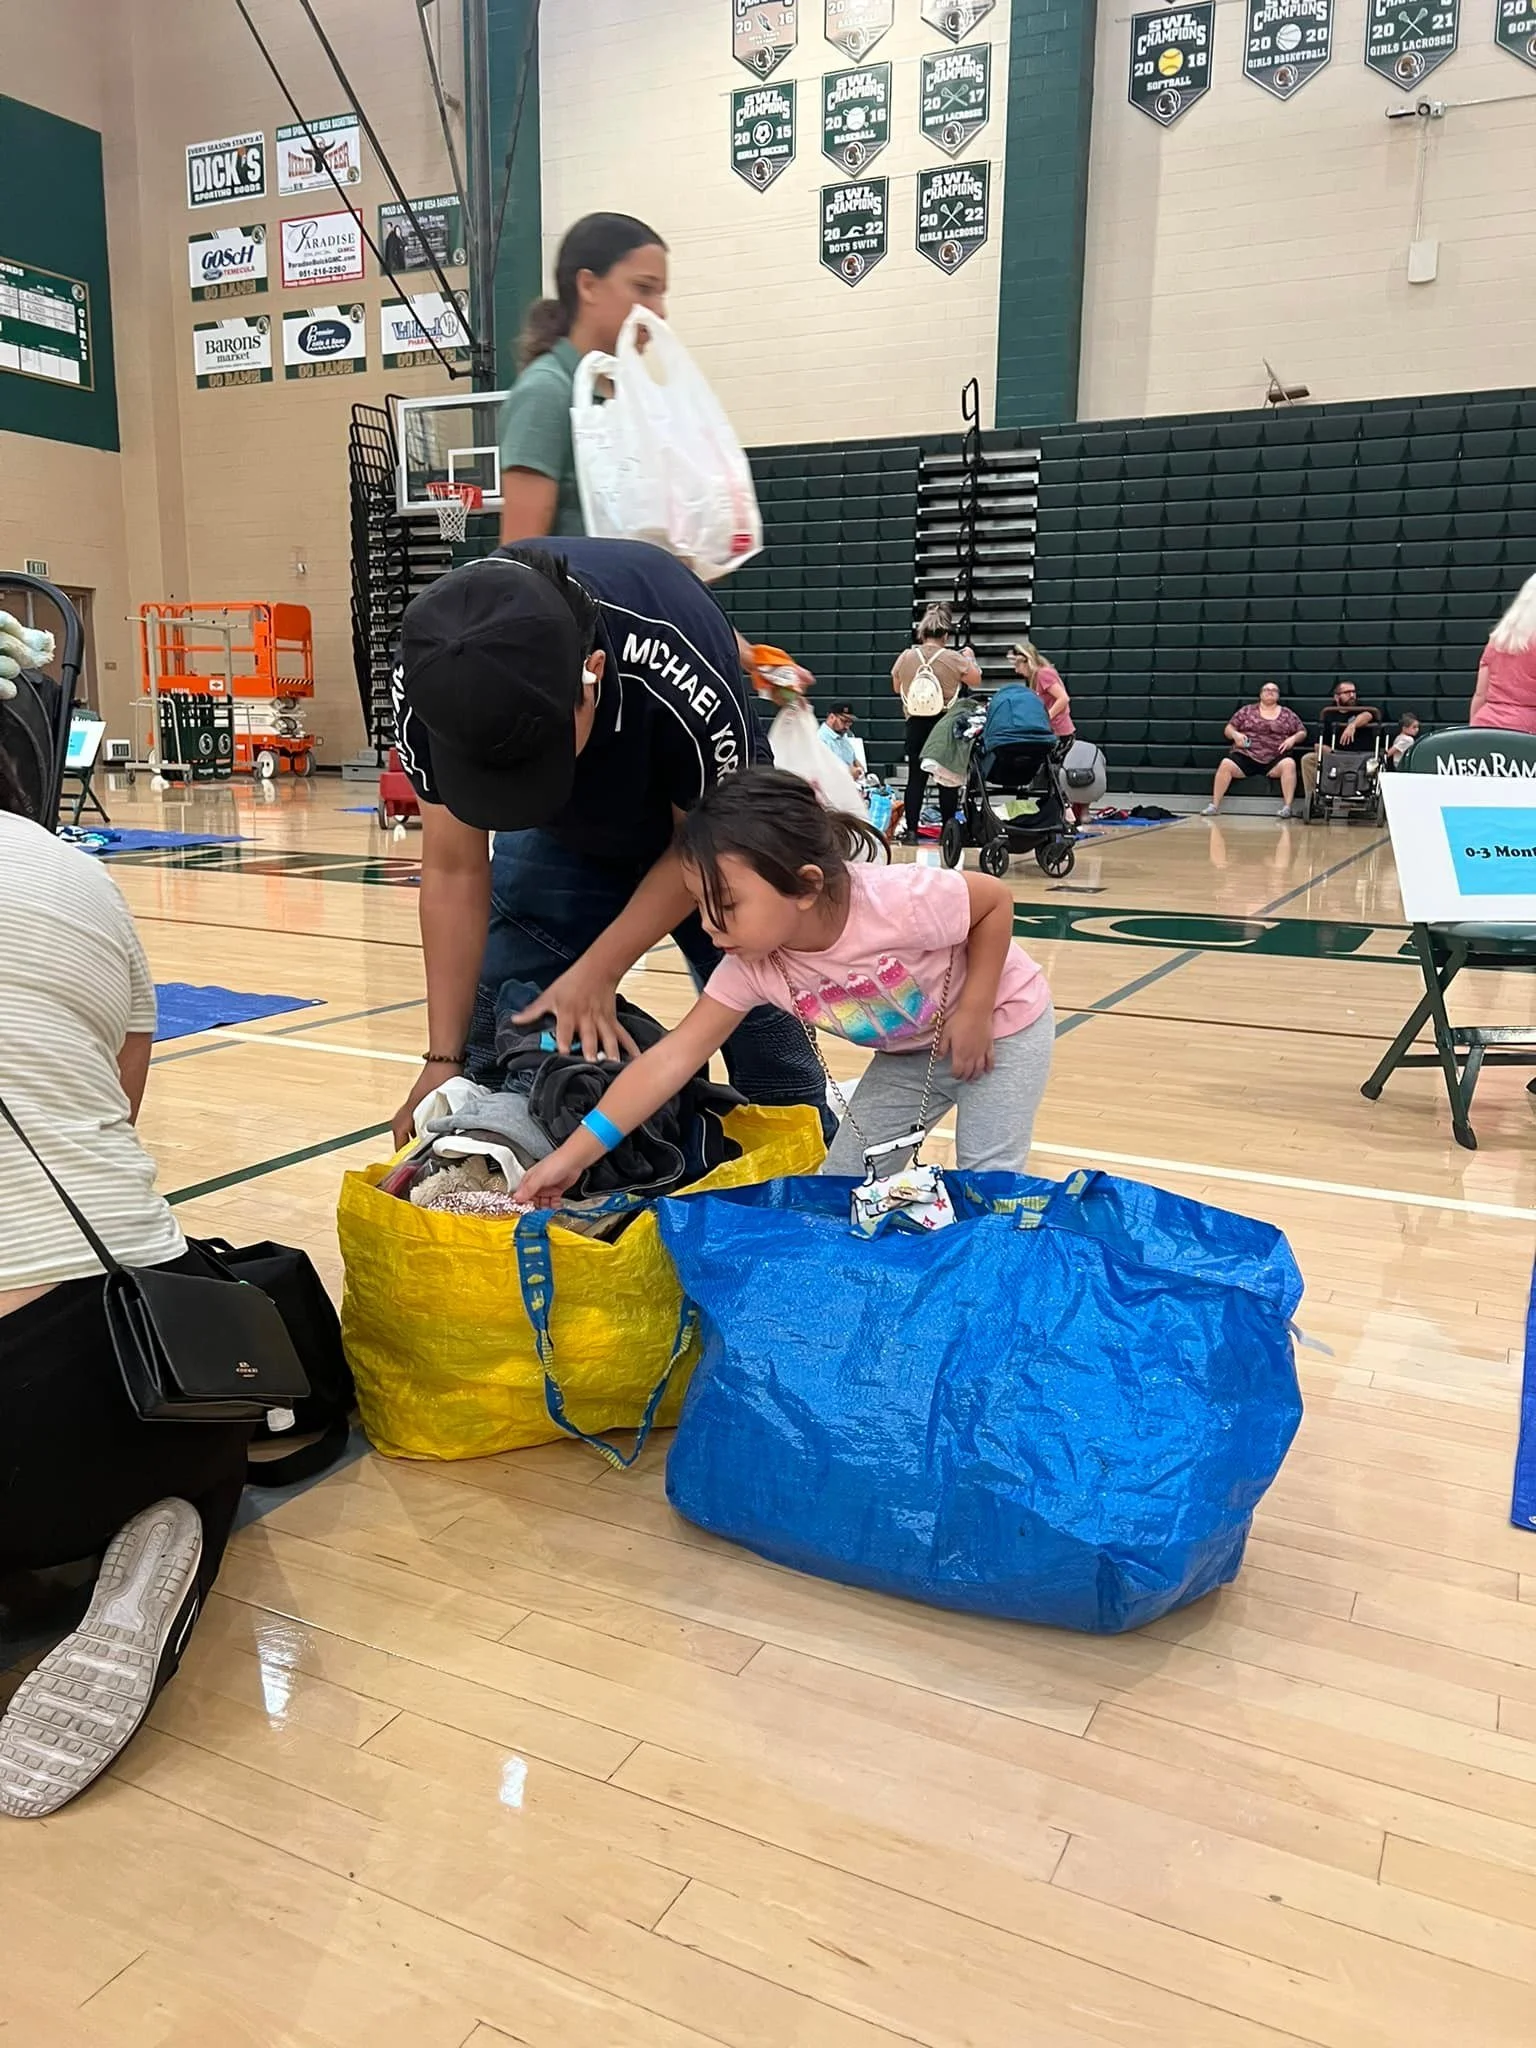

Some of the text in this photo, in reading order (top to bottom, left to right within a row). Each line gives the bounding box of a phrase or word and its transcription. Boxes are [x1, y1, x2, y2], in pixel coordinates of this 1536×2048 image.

[1254, 2, 1328, 32] CHAMPIONS
[1503, 0, 1527, 17] 20
[735, 20, 752, 34] 20
[1149, 13, 1197, 33] SWL
[1372, 13, 1454, 39] 20 21
[1137, 25, 1207, 56] CHAMPIONS
[1250, 27, 1328, 52] 20 20
[1402, 34, 1454, 50] LACROSSE
[1134, 53, 1207, 77] 20 18
[926, 64, 985, 92] CHAMPIONS
[1146, 76, 1191, 91] SOFTBALL
[827, 83, 886, 111] CHAMPIONS
[924, 89, 985, 112] 20 17
[736, 97, 791, 127] CHAMPIONS
[825, 109, 886, 132] 20 16
[734, 125, 792, 146] 20 15
[834, 130, 876, 145] BASEBALL
[192, 147, 262, 193] DICK'S
[932, 171, 975, 188] SWL
[834, 187, 874, 202] SWL
[923, 181, 983, 208] CHAMPIONS
[826, 196, 882, 222] CHAMPIONS
[920, 207, 984, 227] 20 22
[824, 221, 883, 241] 20 22
[944, 225, 984, 240] LACROSSE
[853, 238, 878, 250] SWIM
[711, 722, 739, 787] YOR
[1465, 847, 1491, 859] 0-3
